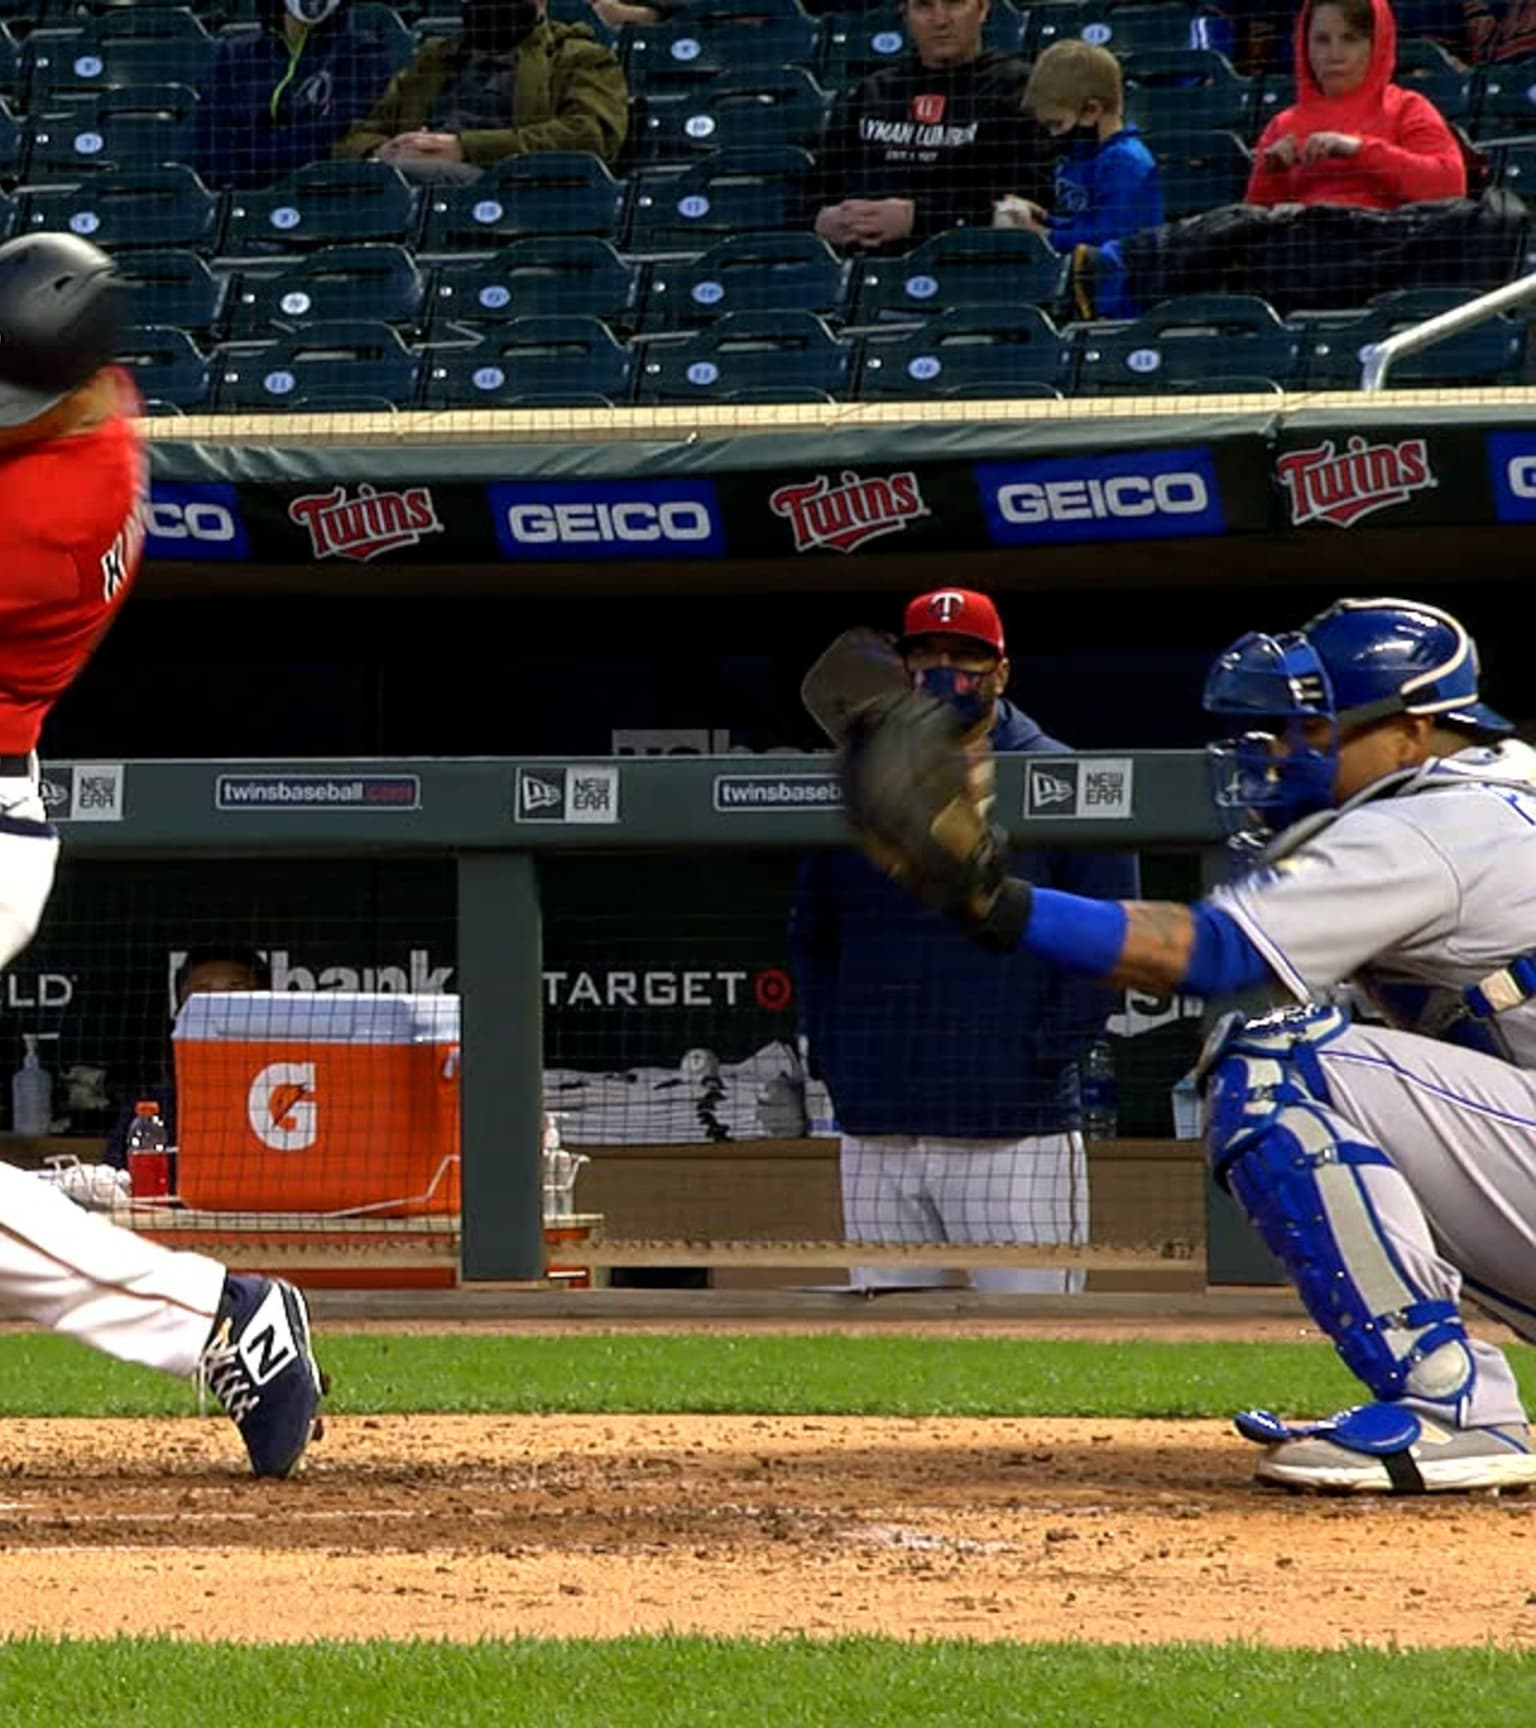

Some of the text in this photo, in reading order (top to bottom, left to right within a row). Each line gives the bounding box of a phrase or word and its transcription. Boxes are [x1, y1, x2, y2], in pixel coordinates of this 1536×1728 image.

[997, 472, 1208, 523] GEICO
[1276, 436, 1438, 530] Twins
[289, 483, 444, 562] Twins
[508, 502, 711, 543] GEICO
[769, 471, 931, 553] Twins
[79, 776, 116, 795] NEW
[574, 777, 611, 793] NEW
[723, 781, 842, 802] twinsbaseb
[1086, 771, 1124, 787] NEW
[1086, 788, 1124, 805] ERA
[79, 791, 115, 810] ERA
[573, 793, 611, 811] ERA
[542, 971, 747, 1006] TARGET
[248, 1062, 317, 1151] G
[247, 1324, 289, 1378] N
